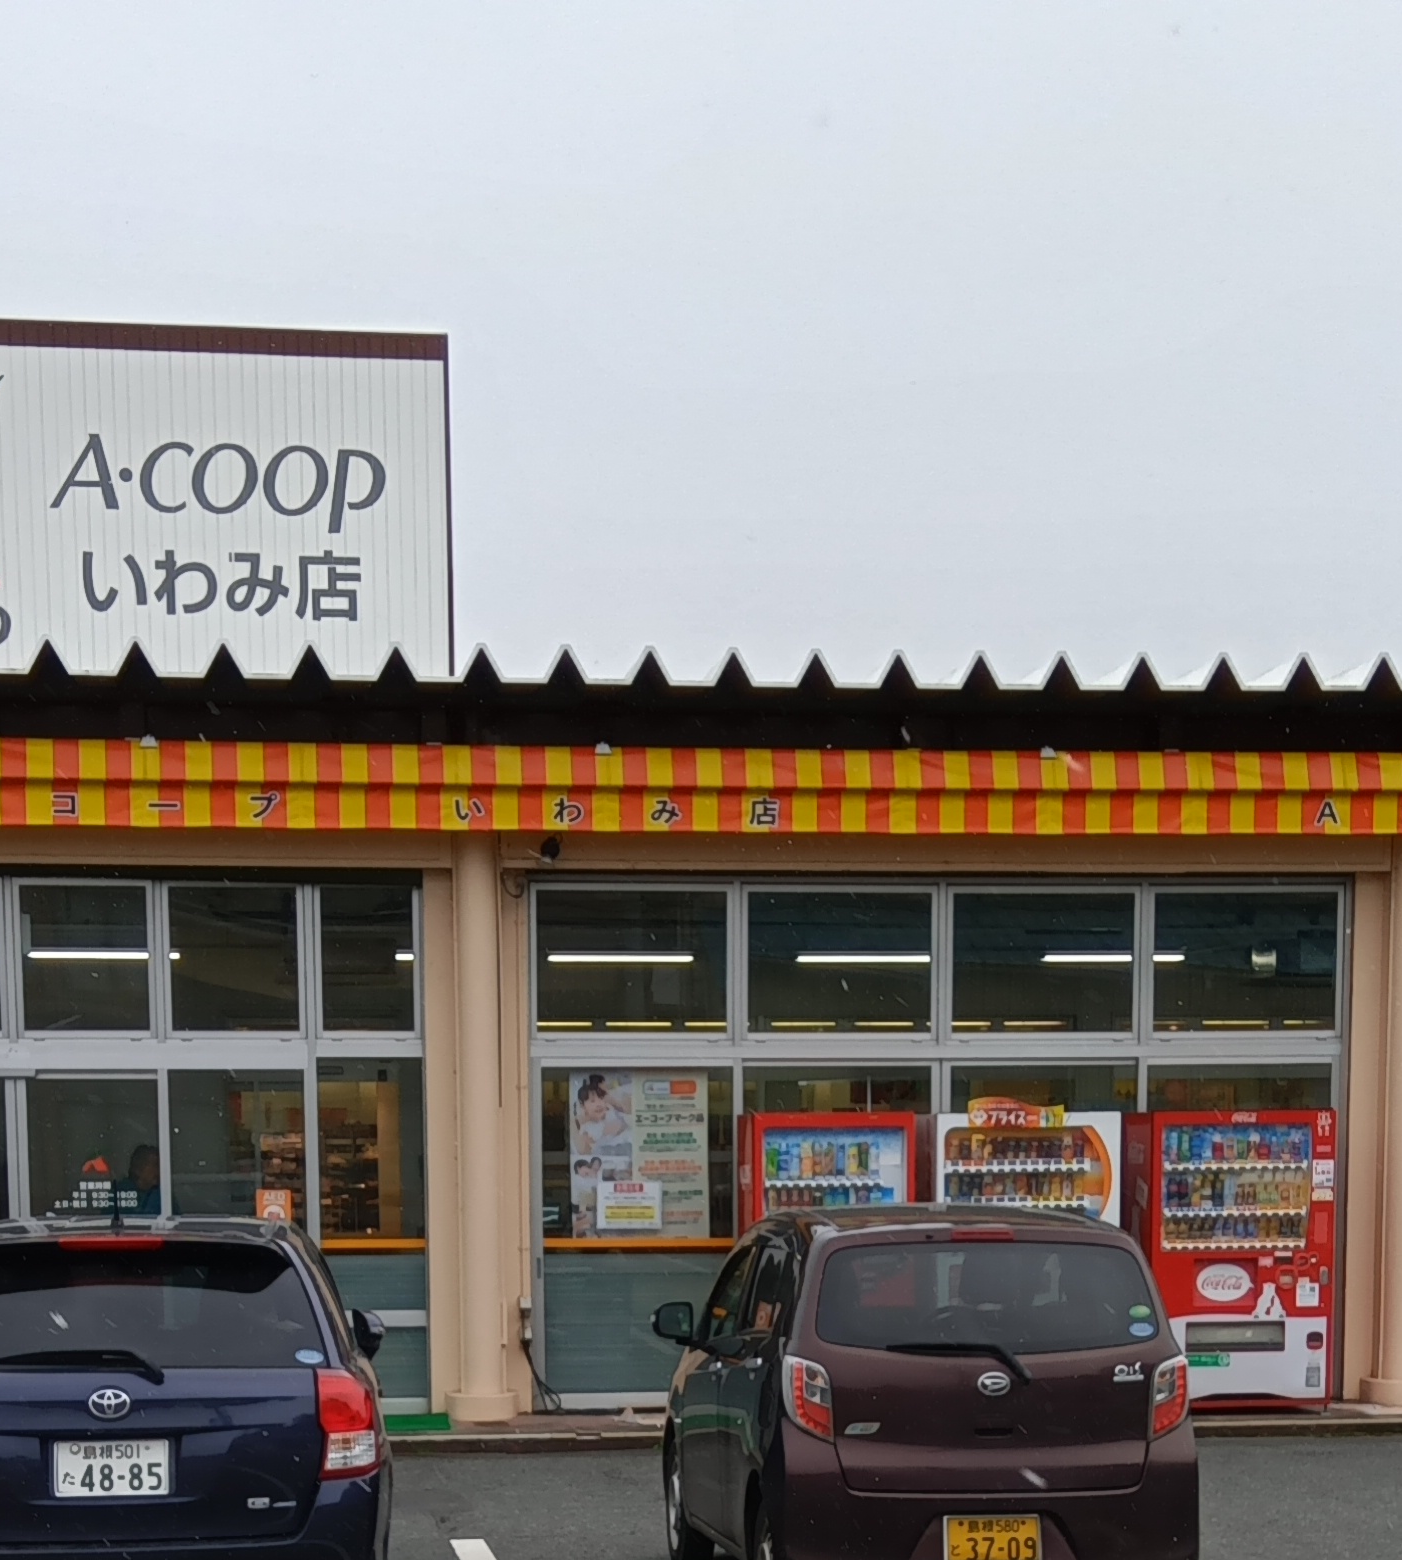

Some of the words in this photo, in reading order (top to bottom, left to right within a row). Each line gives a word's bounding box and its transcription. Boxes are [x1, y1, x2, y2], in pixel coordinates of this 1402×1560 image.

[81, 549, 363, 622] いわみ店
[61, 1471, 76, 1485] た
[80, 1462, 163, 1493] 48-85
